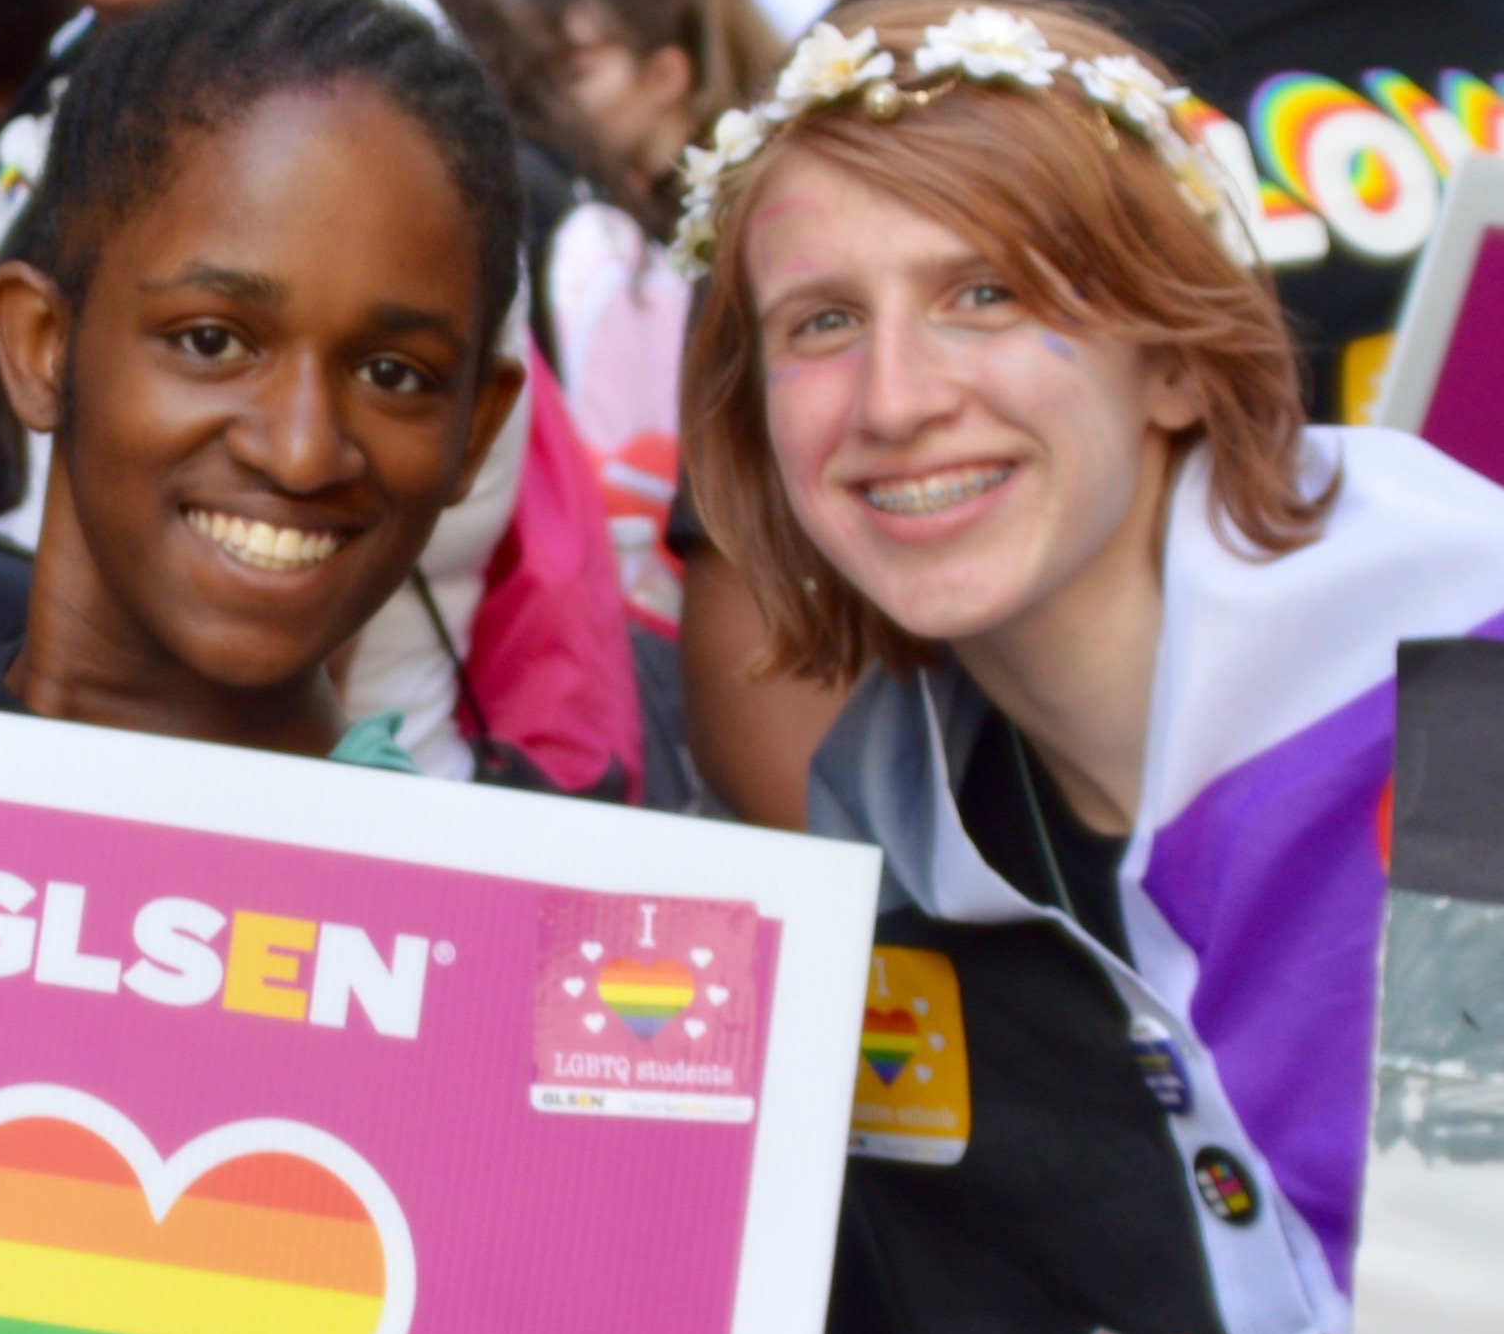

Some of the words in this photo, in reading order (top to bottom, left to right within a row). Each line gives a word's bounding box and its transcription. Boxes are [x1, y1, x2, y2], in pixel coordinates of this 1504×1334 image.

[637, 903, 657, 948] I
[553, 1051, 632, 1085] LGBTQ
[635, 1059, 735, 1086] students
